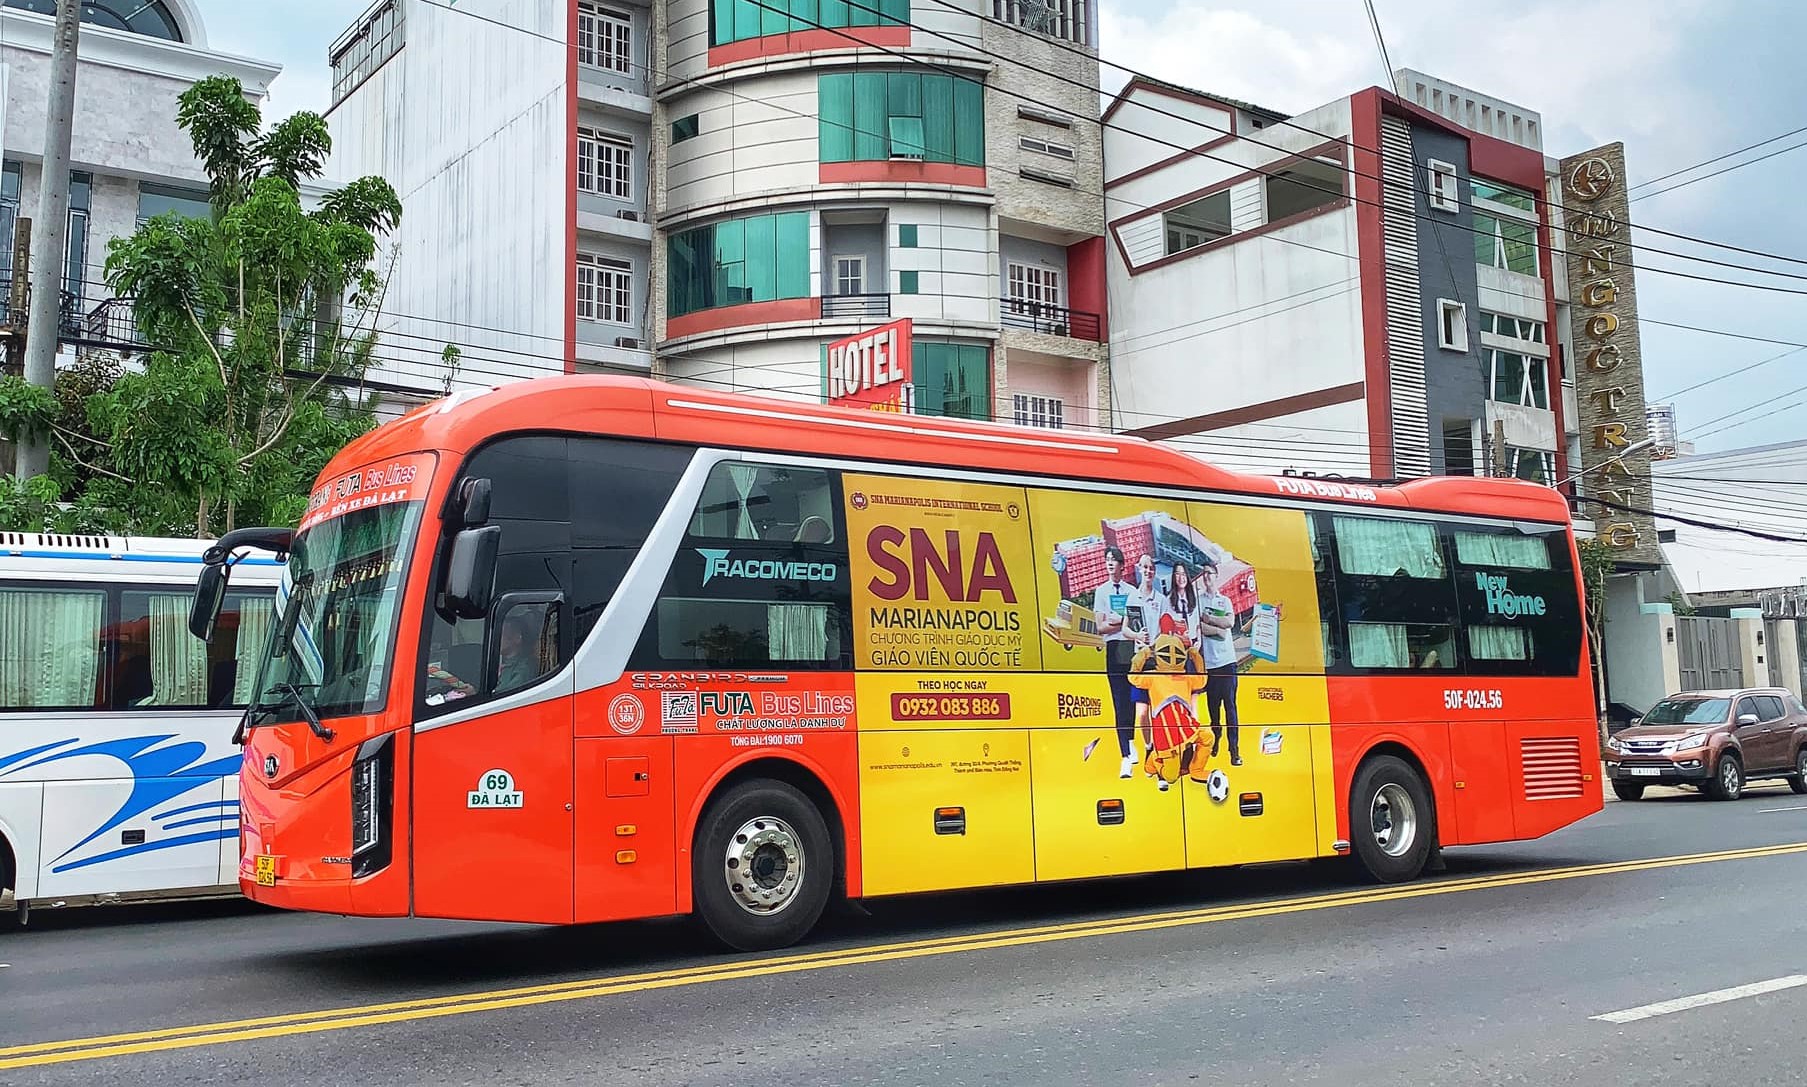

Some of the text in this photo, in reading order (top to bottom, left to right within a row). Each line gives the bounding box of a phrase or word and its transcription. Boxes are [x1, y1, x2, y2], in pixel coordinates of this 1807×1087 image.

[830, 328, 904, 399] HOTEL
[1591, 387, 1641, 548] TRANG
[333, 463, 417, 501] FUTA Bus Lines
[1275, 480, 1377, 501] FUTA Bus Lines
[694, 548, 837, 588] TRACOMECO
[866, 525, 1018, 604] SNA
[1475, 572, 1508, 591] New
[1486, 589, 1546, 616] Home
[870, 607, 1020, 632] MARIANAPOLIS
[870, 632, 921, 646] CHƯƠNG
[924, 631, 954, 646] TRÌNH
[956, 631, 981, 647] GIÁO
[984, 634, 1007, 649] DỤC
[871, 646, 911, 667] GIÁO
[915, 647, 950, 667] VIÊN
[955, 647, 1000, 668] QUỐC
[917, 680, 987, 692] THEO HỌC NGAY
[700, 691, 854, 717] FUTA Bus Lines
[1057, 693, 1101, 707] BOARDING
[1258, 692, 1284, 701] TEACHERS
[1443, 689, 1503, 709] 50F-024.56
[619, 704, 634, 713] 13T
[899, 698, 1000, 716] 0932 083 886
[1058, 704, 1101, 720] FACILITIES
[716, 716, 846, 732] CHẤT LƯỢNG LÀ DANH DỰ
[784, 734, 804, 745] 6070
[486, 774, 508, 790] 69
[471, 791, 520, 807] ĐÀ LẠT
